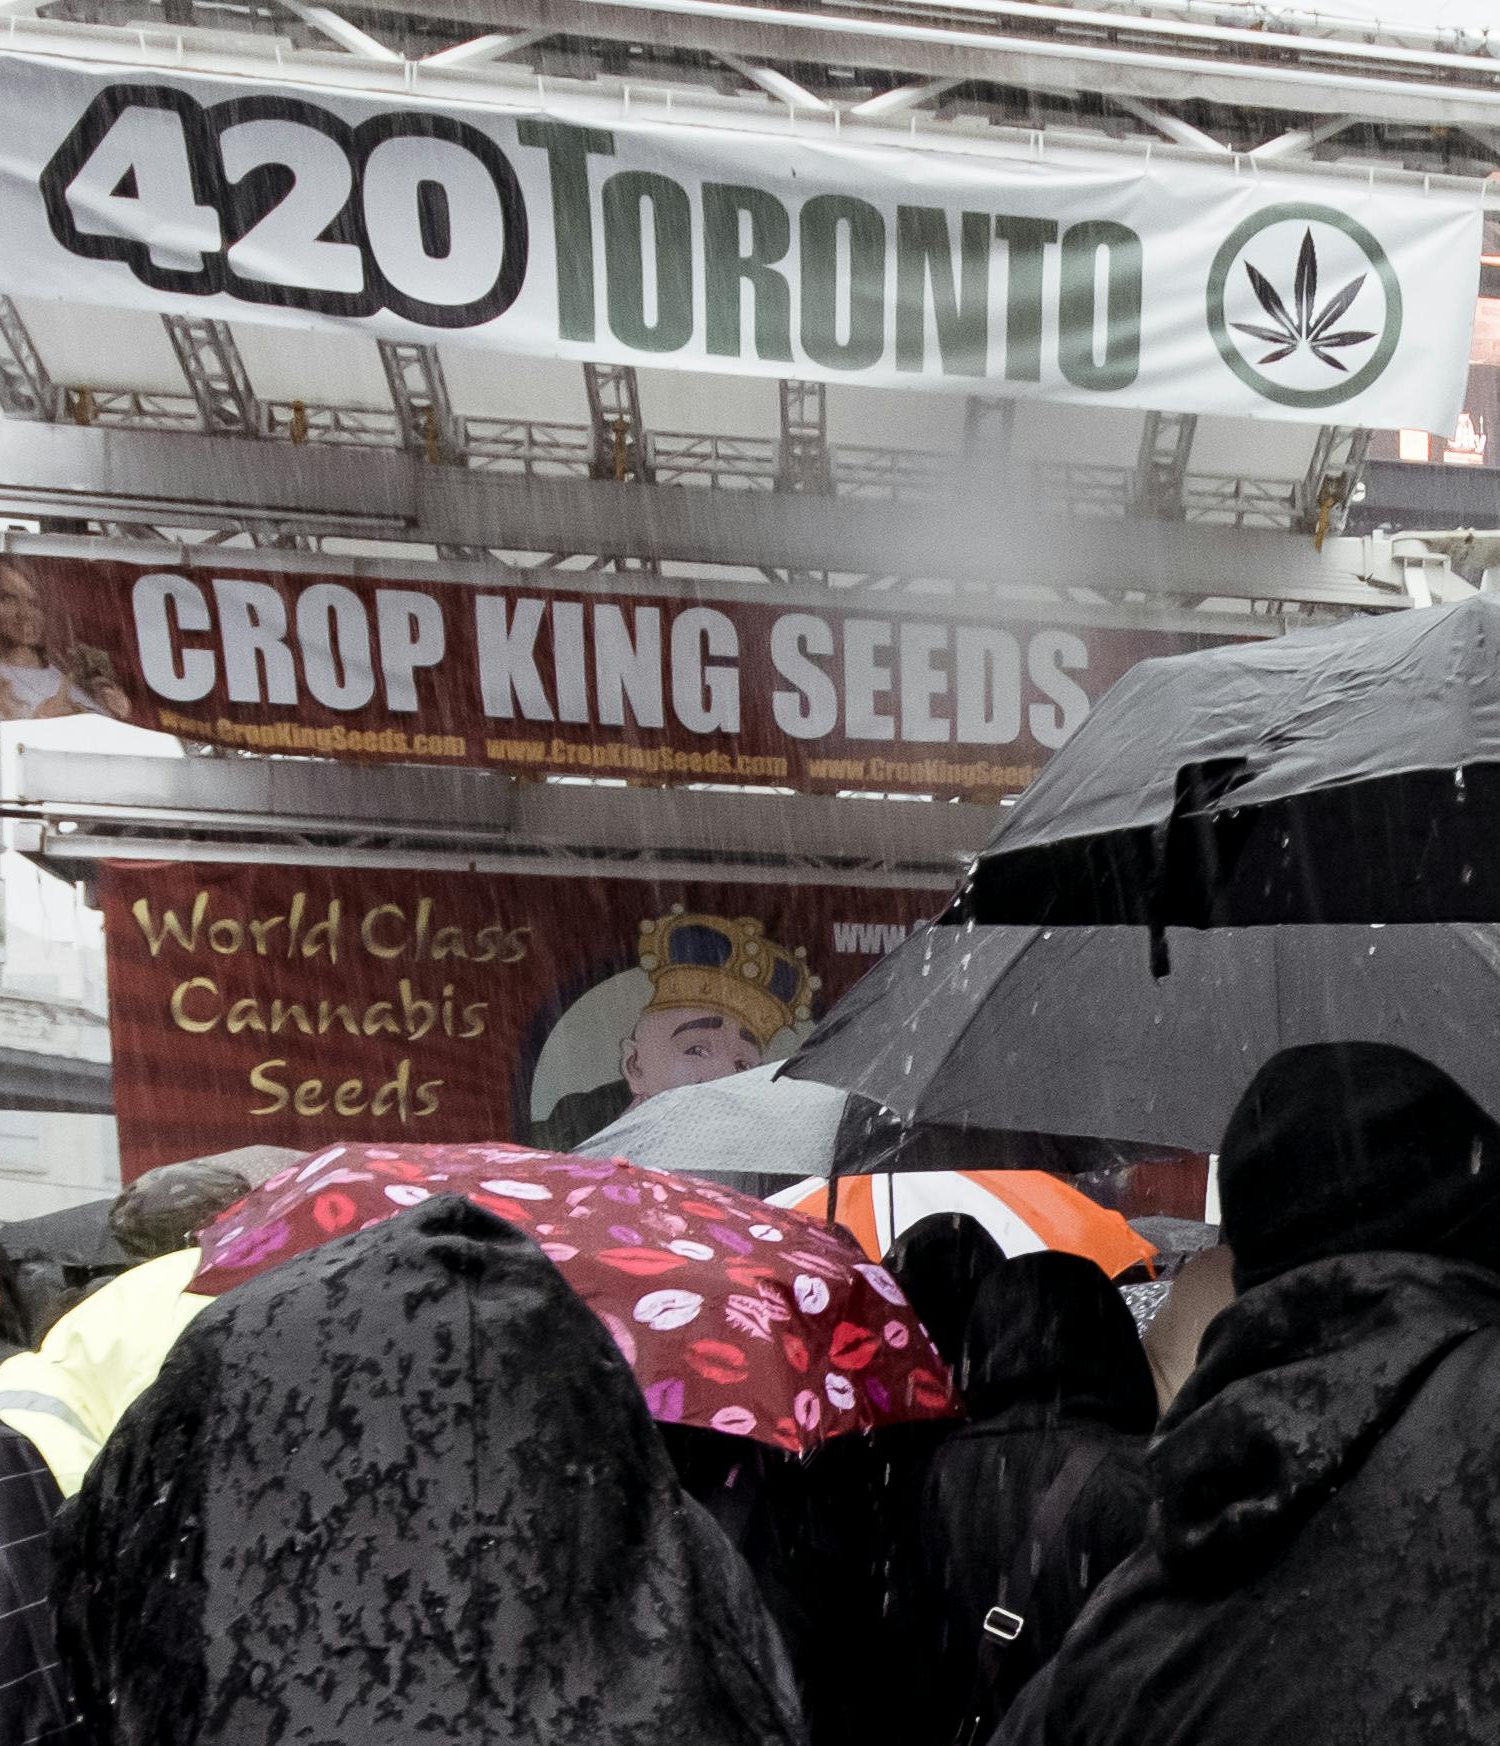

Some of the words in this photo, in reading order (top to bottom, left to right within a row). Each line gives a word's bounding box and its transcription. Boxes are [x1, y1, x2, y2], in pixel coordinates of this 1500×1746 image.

[132, 573, 445, 712] CROP
[475, 595, 741, 735] KING
[771, 613, 1092, 750] SEEDS
[486, 738, 789, 778] www.CropKingSeeds.com
[132, 891, 340, 965] World
[361, 897, 534, 963] Class
[171, 976, 489, 1041] Cannabis
[249, 1058, 445, 1123] Seeds
